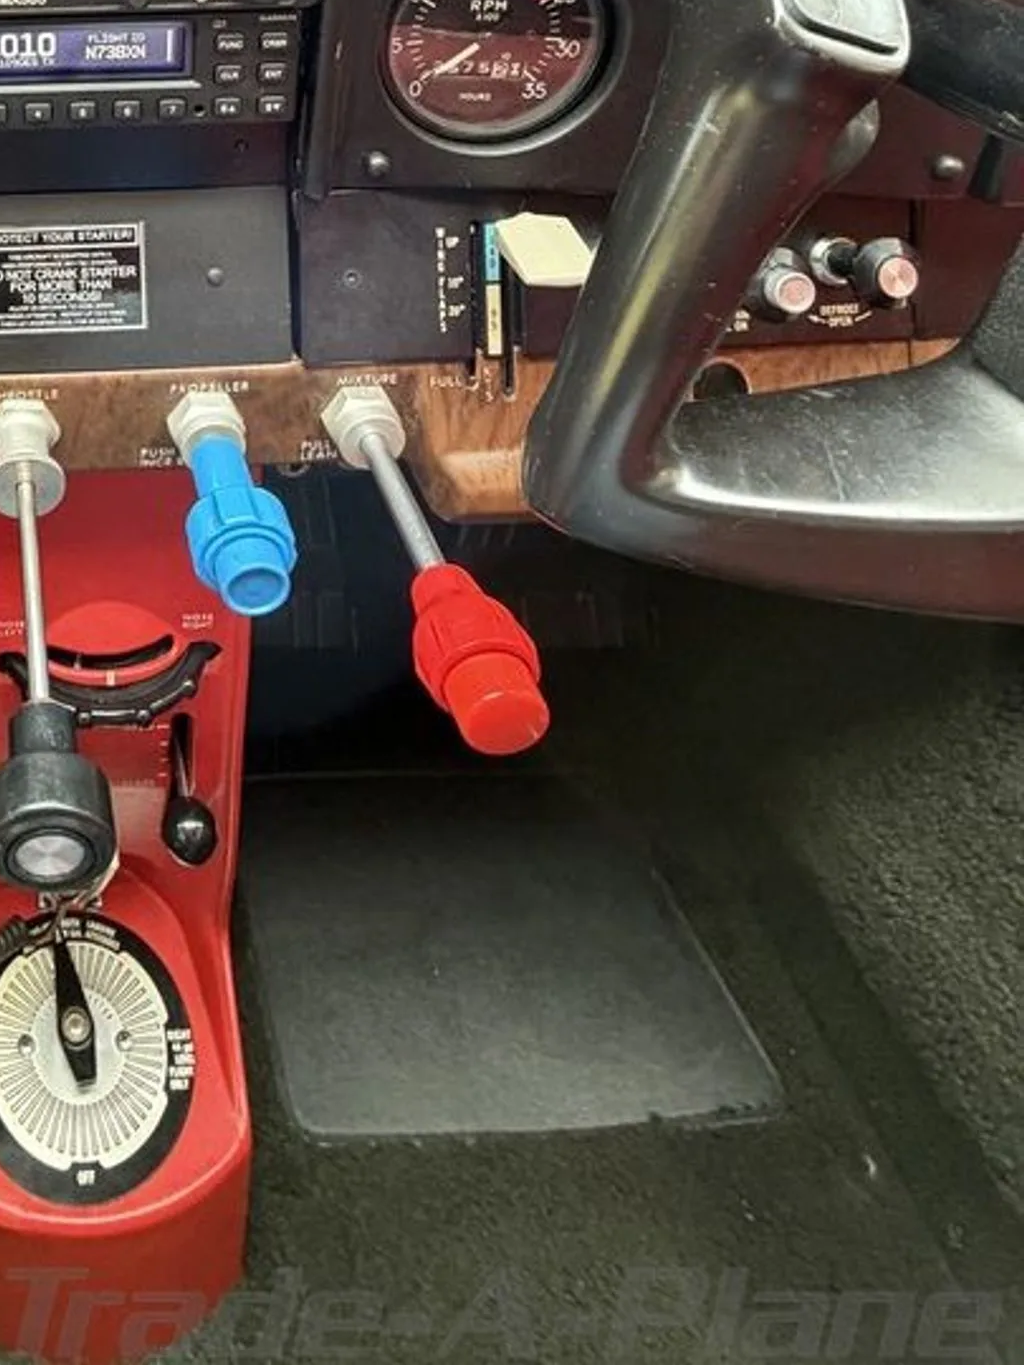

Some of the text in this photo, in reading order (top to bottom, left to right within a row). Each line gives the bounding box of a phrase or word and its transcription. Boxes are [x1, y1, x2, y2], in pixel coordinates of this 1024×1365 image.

[85, 44, 146, 60] N738XN
[391, 38, 403, 53] 5
[555, 40, 581, 59] 30
[408, 81, 422, 97] 0
[521, 81, 547, 100] 35
[458, 92, 492, 102] HOURS
[42, 231, 75, 244] YOUR
[5, 268, 32, 282] NOT
[34, 267, 78, 281] CRANK
[79, 264, 138, 279] STARTER
[9, 278, 113, 293] FOR MORE THAN
[22, 292, 36, 304] 10
[169, 380, 250, 395] PROPELLER
[335, 373, 399, 387] MIXTURE
[429, 374, 462, 389] FULL
[140, 446, 176, 458] PUSH
[300, 450, 337, 461] LEAN
